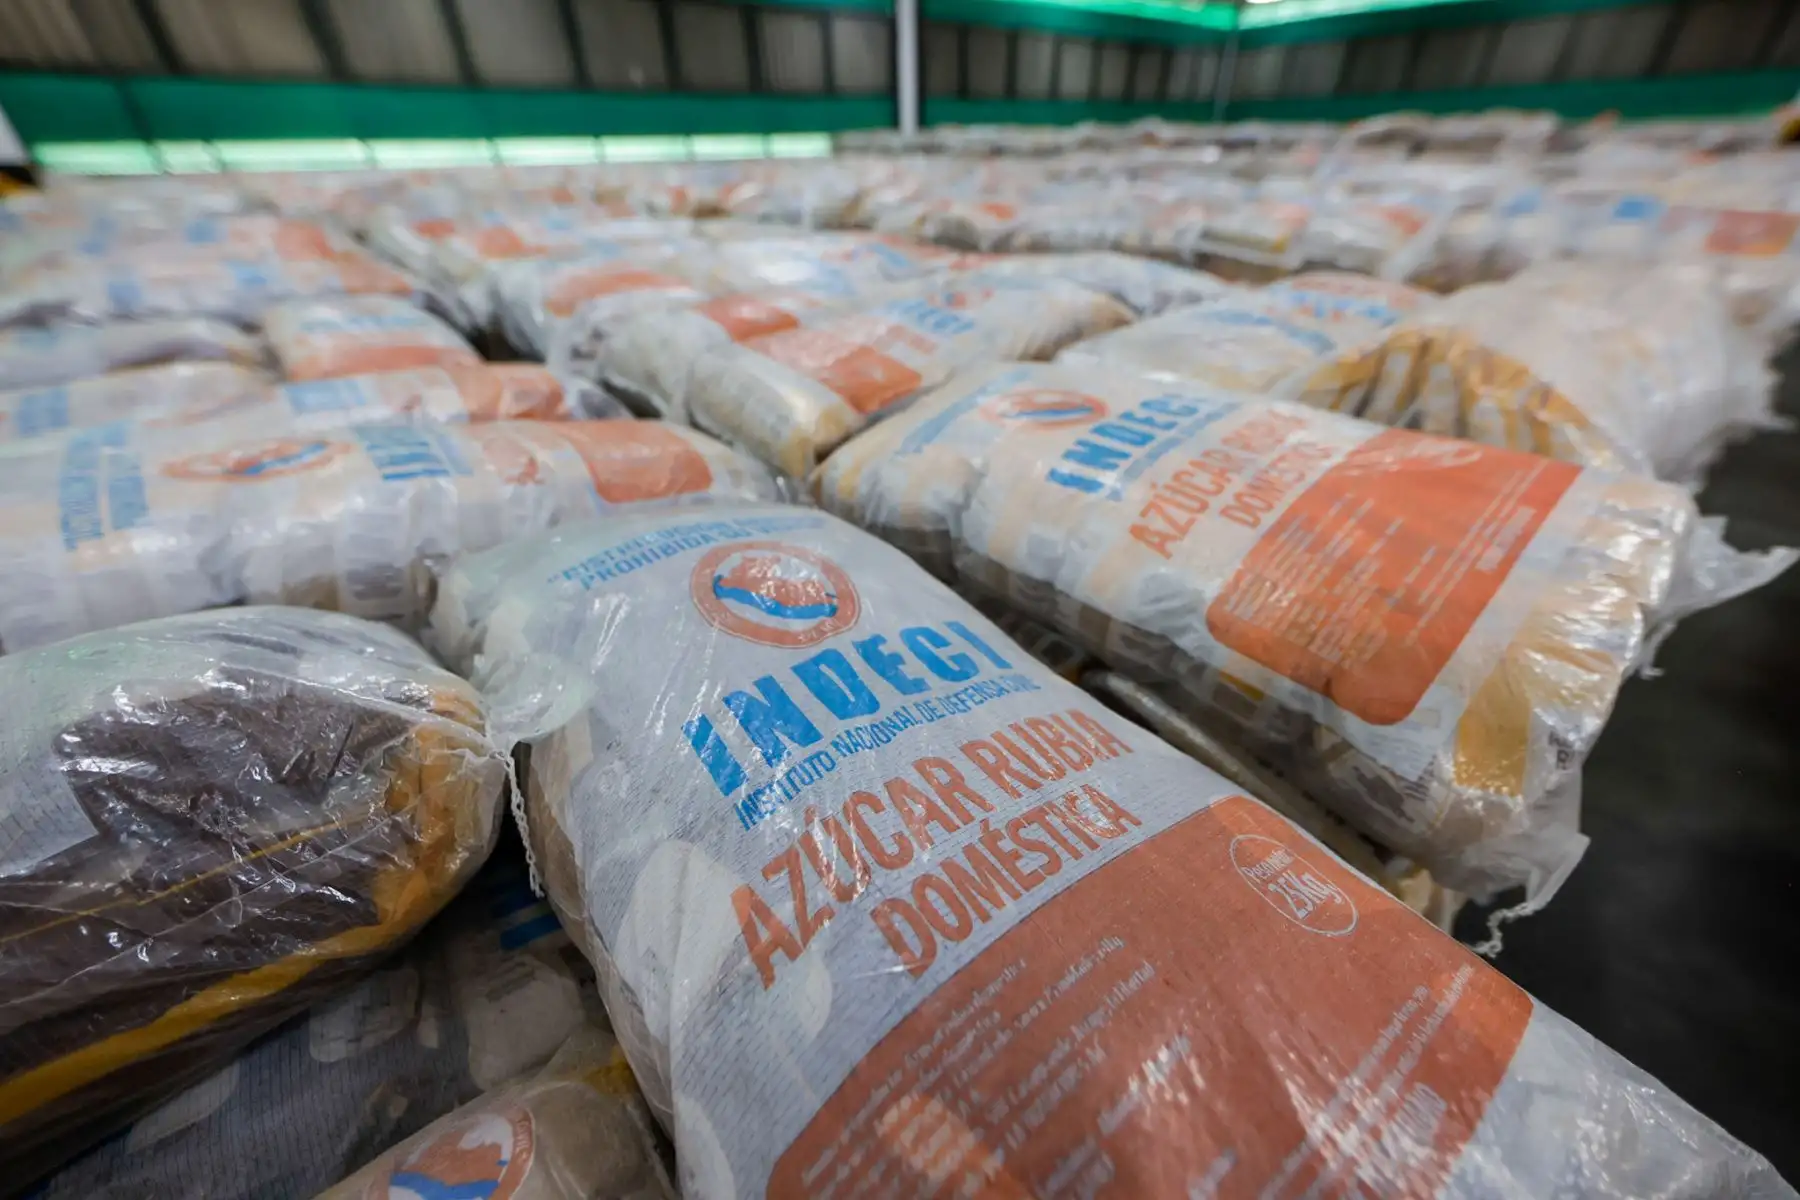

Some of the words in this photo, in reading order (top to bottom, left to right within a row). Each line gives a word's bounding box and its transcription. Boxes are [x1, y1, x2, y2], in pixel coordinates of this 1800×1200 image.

[681, 620, 1013, 797] INDECI
[732, 749, 837, 831] INSTITUTO
[830, 704, 924, 756] NACIONAL
[917, 696, 947, 724] DE
[940, 678, 1011, 715] DEFENSA
[730, 756, 996, 990] AZÚCAR
[959, 708, 1134, 800] RUBIA
[870, 783, 1143, 979] DOMÉSTICA
